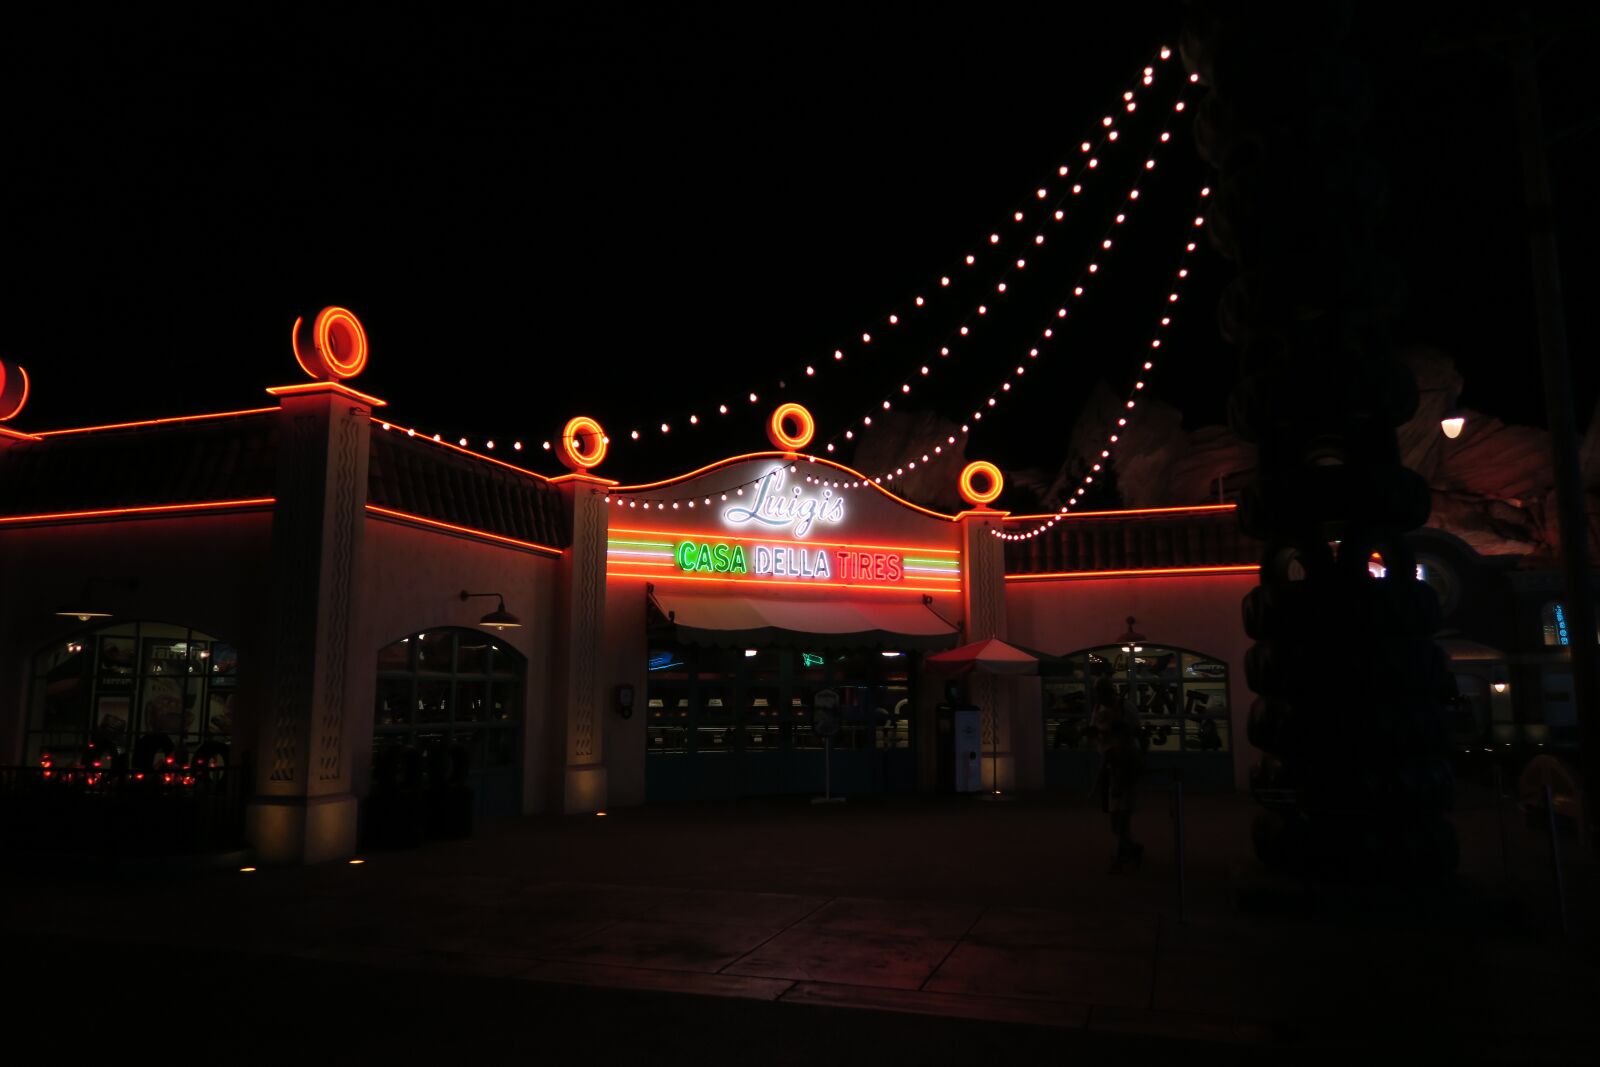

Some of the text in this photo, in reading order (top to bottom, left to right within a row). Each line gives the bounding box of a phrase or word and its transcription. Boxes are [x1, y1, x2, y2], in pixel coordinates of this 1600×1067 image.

[678, 541, 901, 582] CASA DELLA TIRES
